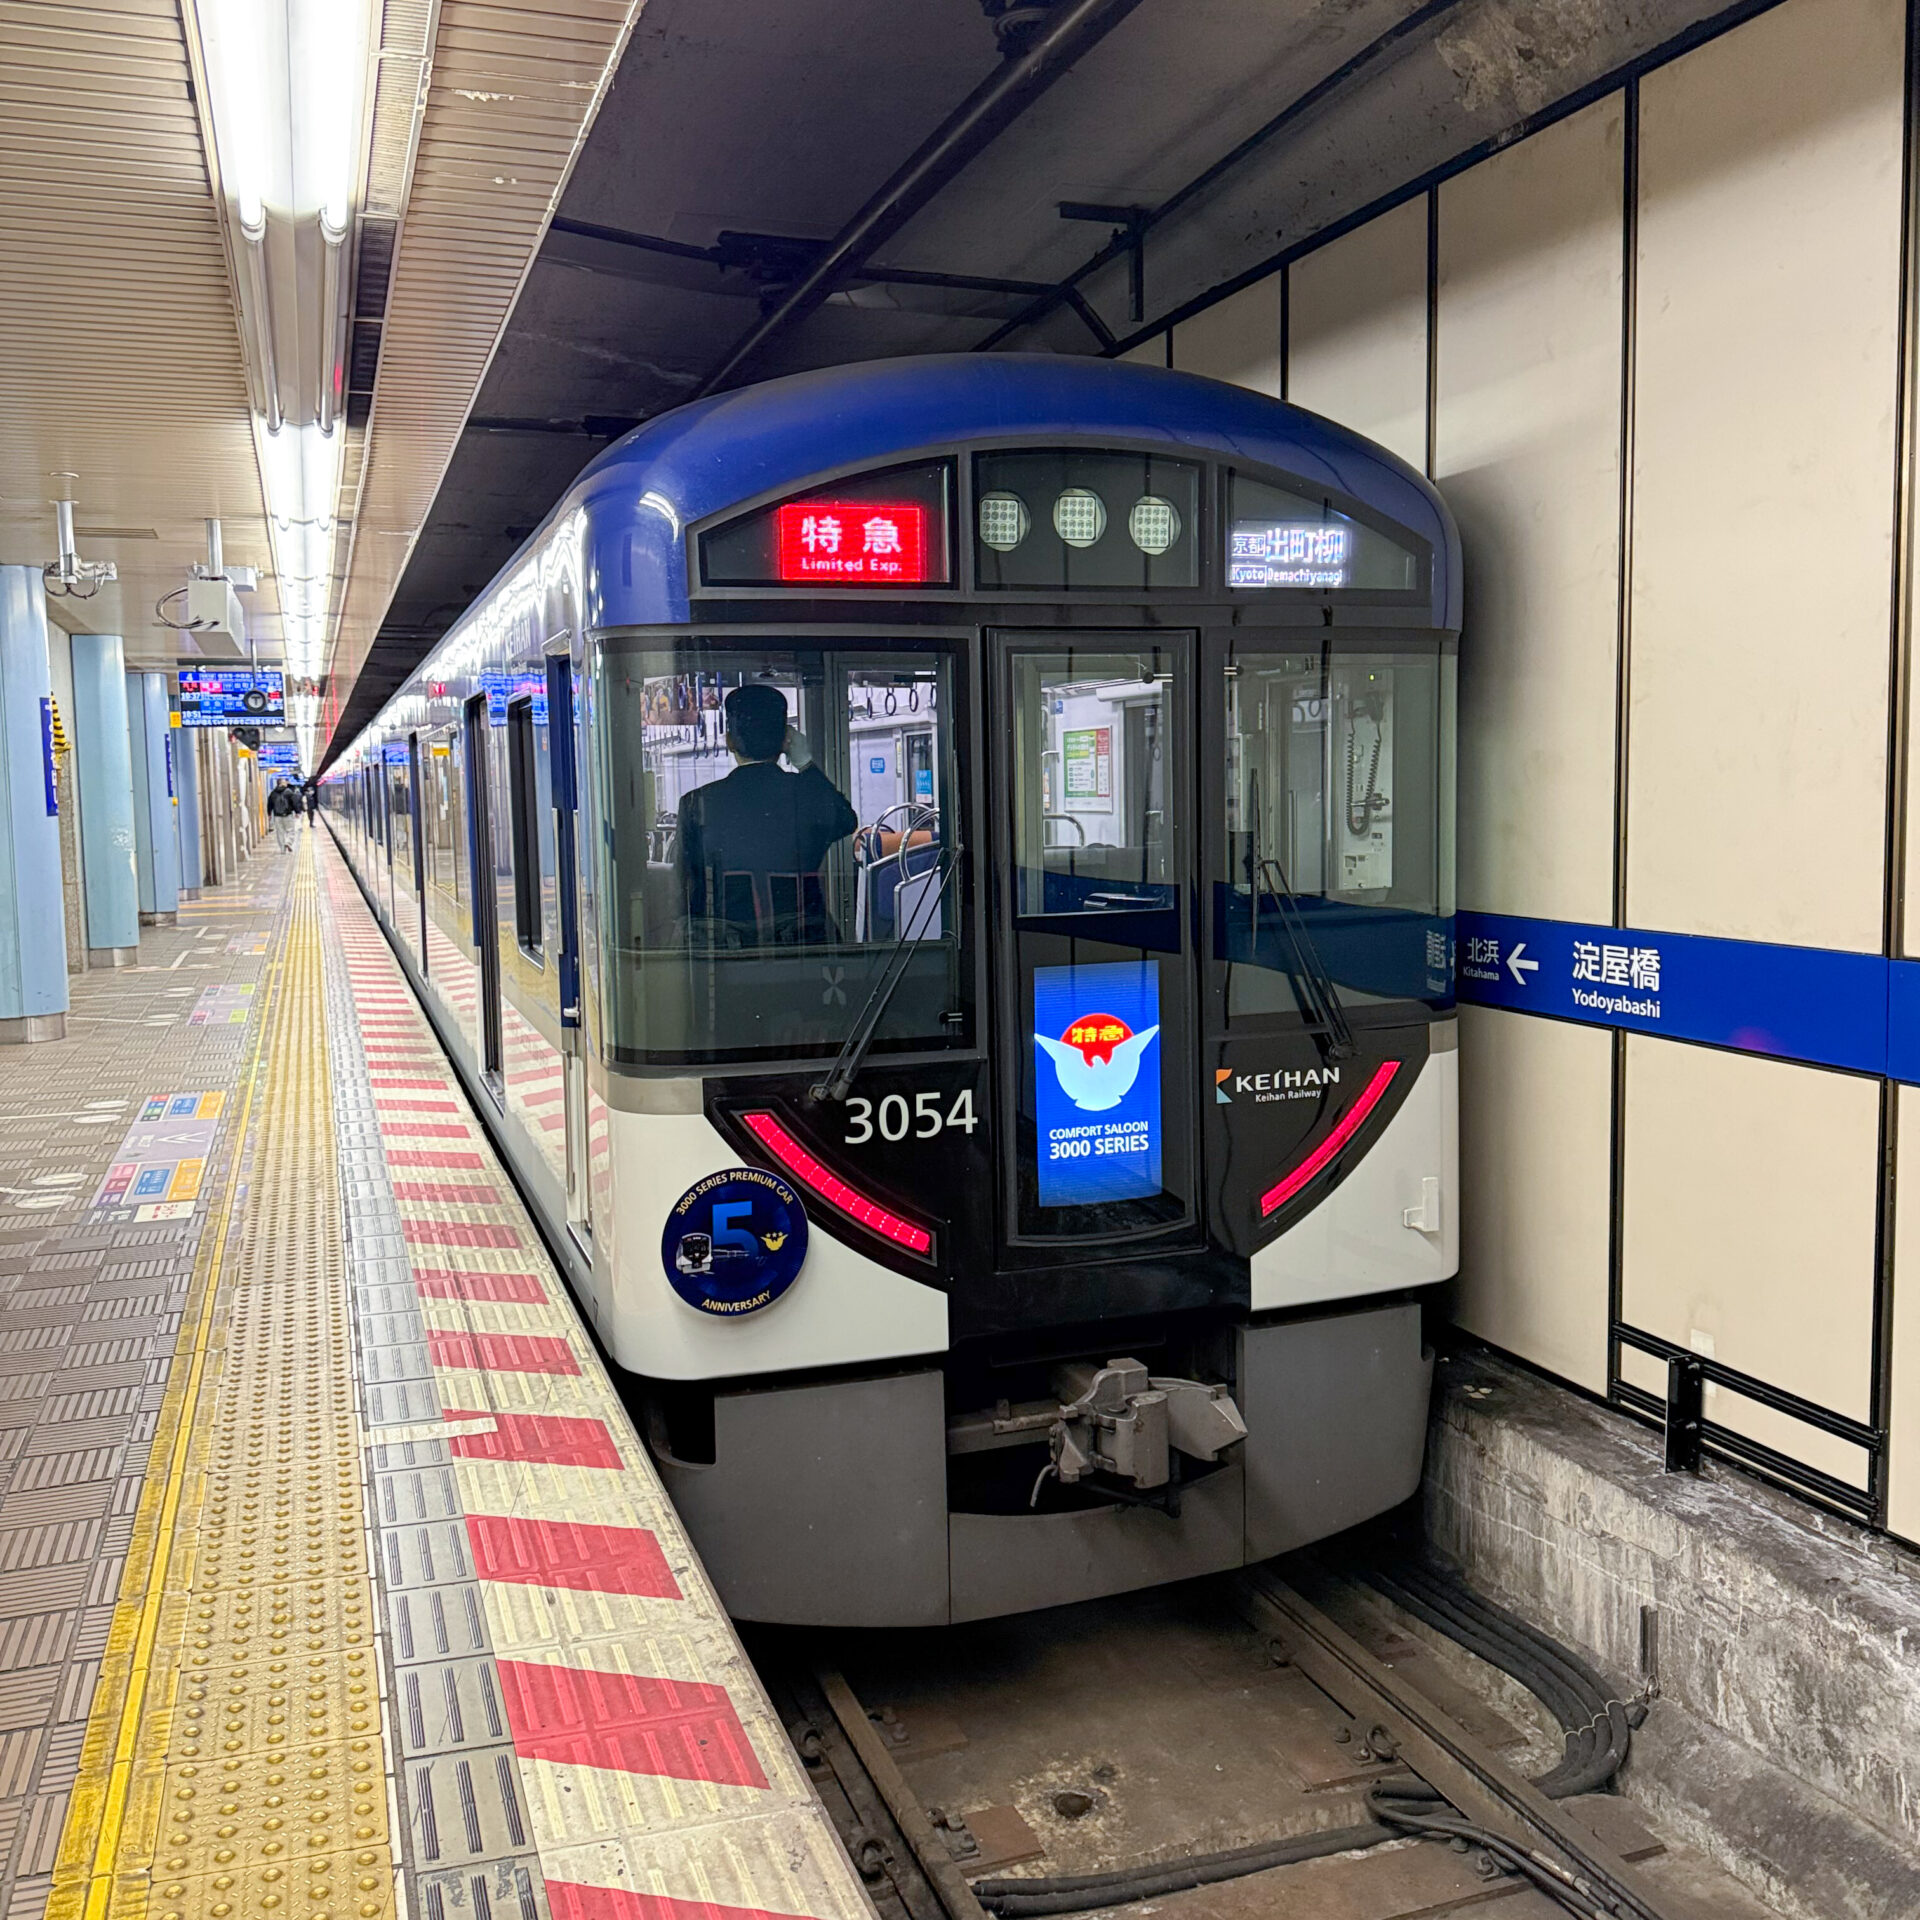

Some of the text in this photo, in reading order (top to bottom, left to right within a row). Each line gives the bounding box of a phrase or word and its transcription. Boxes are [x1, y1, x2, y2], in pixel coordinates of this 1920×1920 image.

[801, 515, 903, 554] 特急
[1232, 527, 1345, 564] 京都 出町柳
[801, 557, 903, 575] Limited Exp.
[1231, 567, 1343, 586] Kyoto Demachiyanagi
[1466, 937, 1500, 966] 北浜
[1462, 966, 1500, 982] Kitahama
[1571, 940, 1661, 993] 淀屋橋
[1571, 988, 1661, 1019] Yodoyabashi
[1071, 1024, 1125, 1045] 特急
[1235, 1066, 1341, 1093] KEIHAN
[1255, 1089, 1322, 1103] Keihan Railway
[844, 1088, 979, 1145] 3054
[1049, 1120, 1150, 1141] COMFORT SALOON
[1049, 1133, 1150, 1160] 3000 SERIES
[675, 1171, 795, 1216] 3000 SERIES PREMIUM CAR
[711, 1200, 761, 1258] 5
[701, 1290, 772, 1313] ANNIVERSARY
